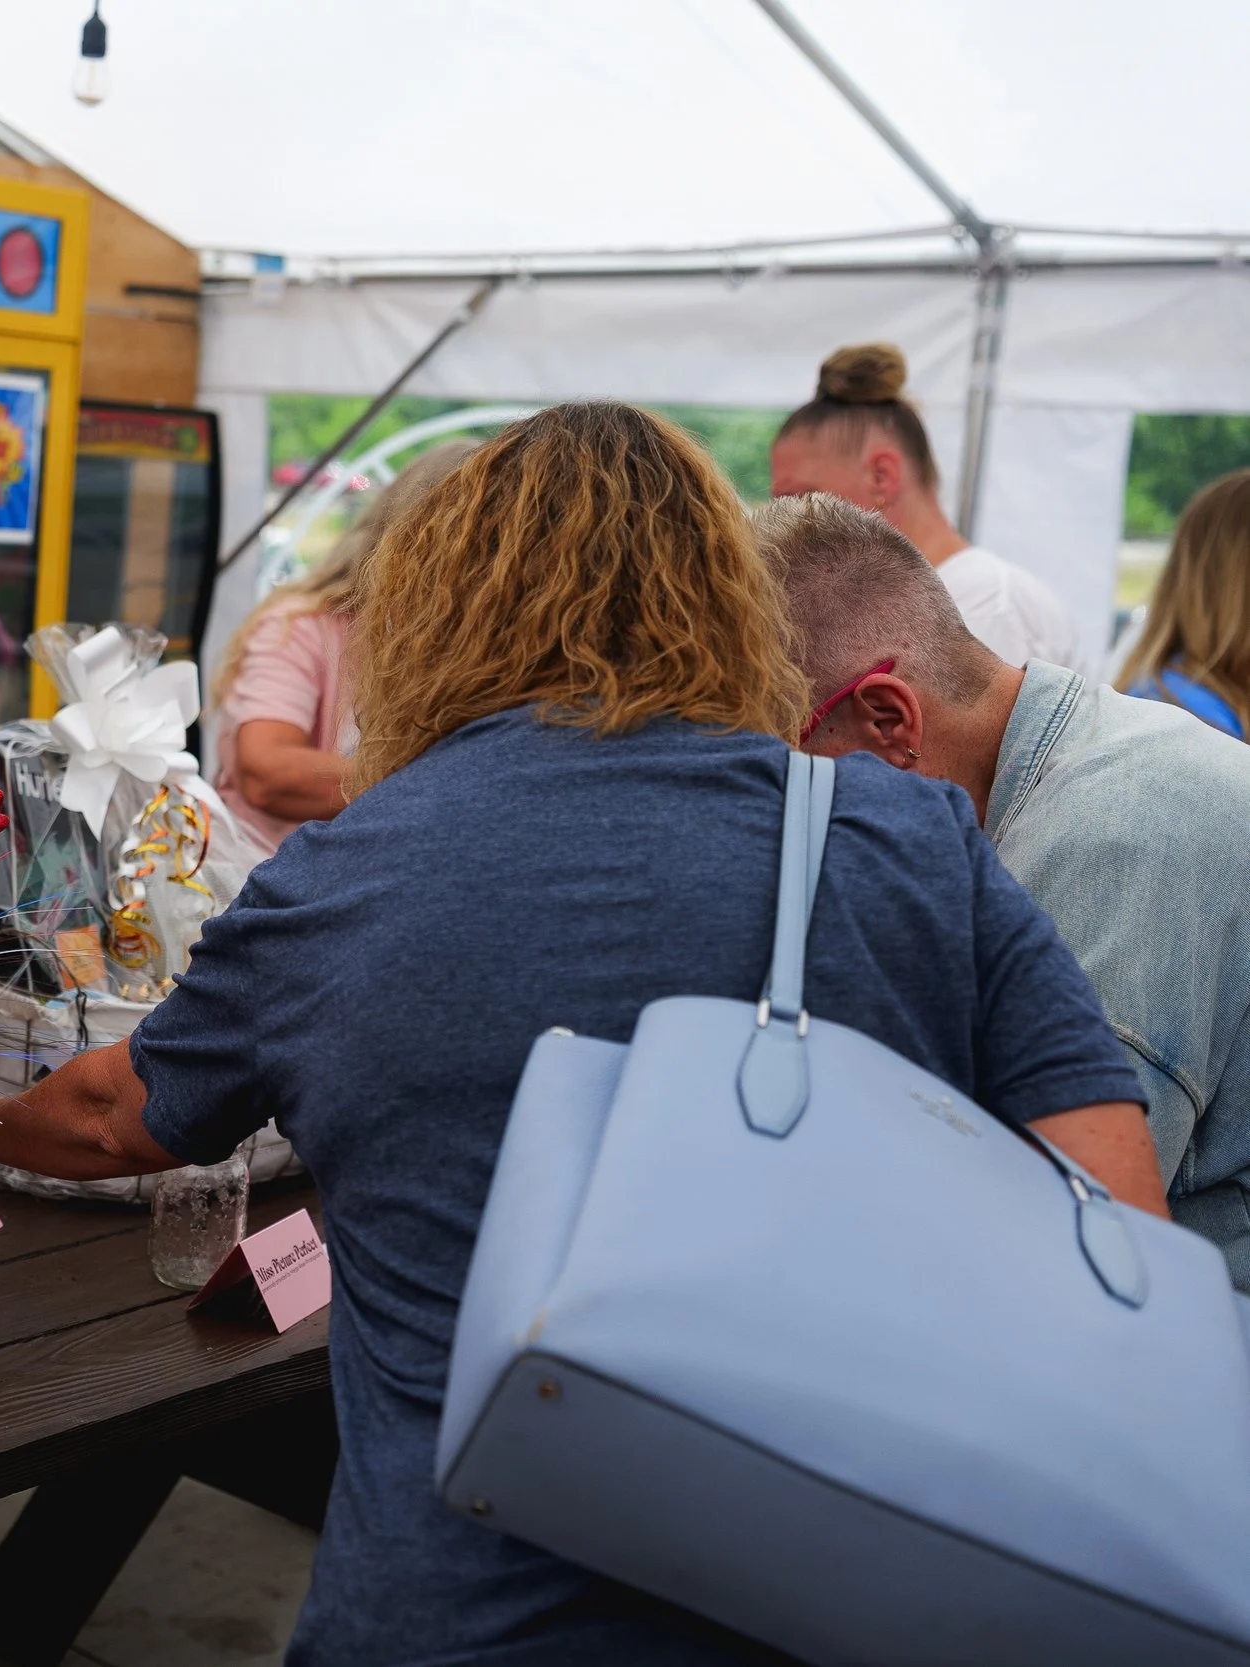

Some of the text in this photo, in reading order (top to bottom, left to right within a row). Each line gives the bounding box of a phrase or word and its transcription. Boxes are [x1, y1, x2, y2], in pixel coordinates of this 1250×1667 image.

[14, 760, 63, 801] Hurle
[255, 1265, 275, 1285] Miss
[272, 1251, 296, 1274] Picture
[293, 1238, 318, 1260] Perfect
